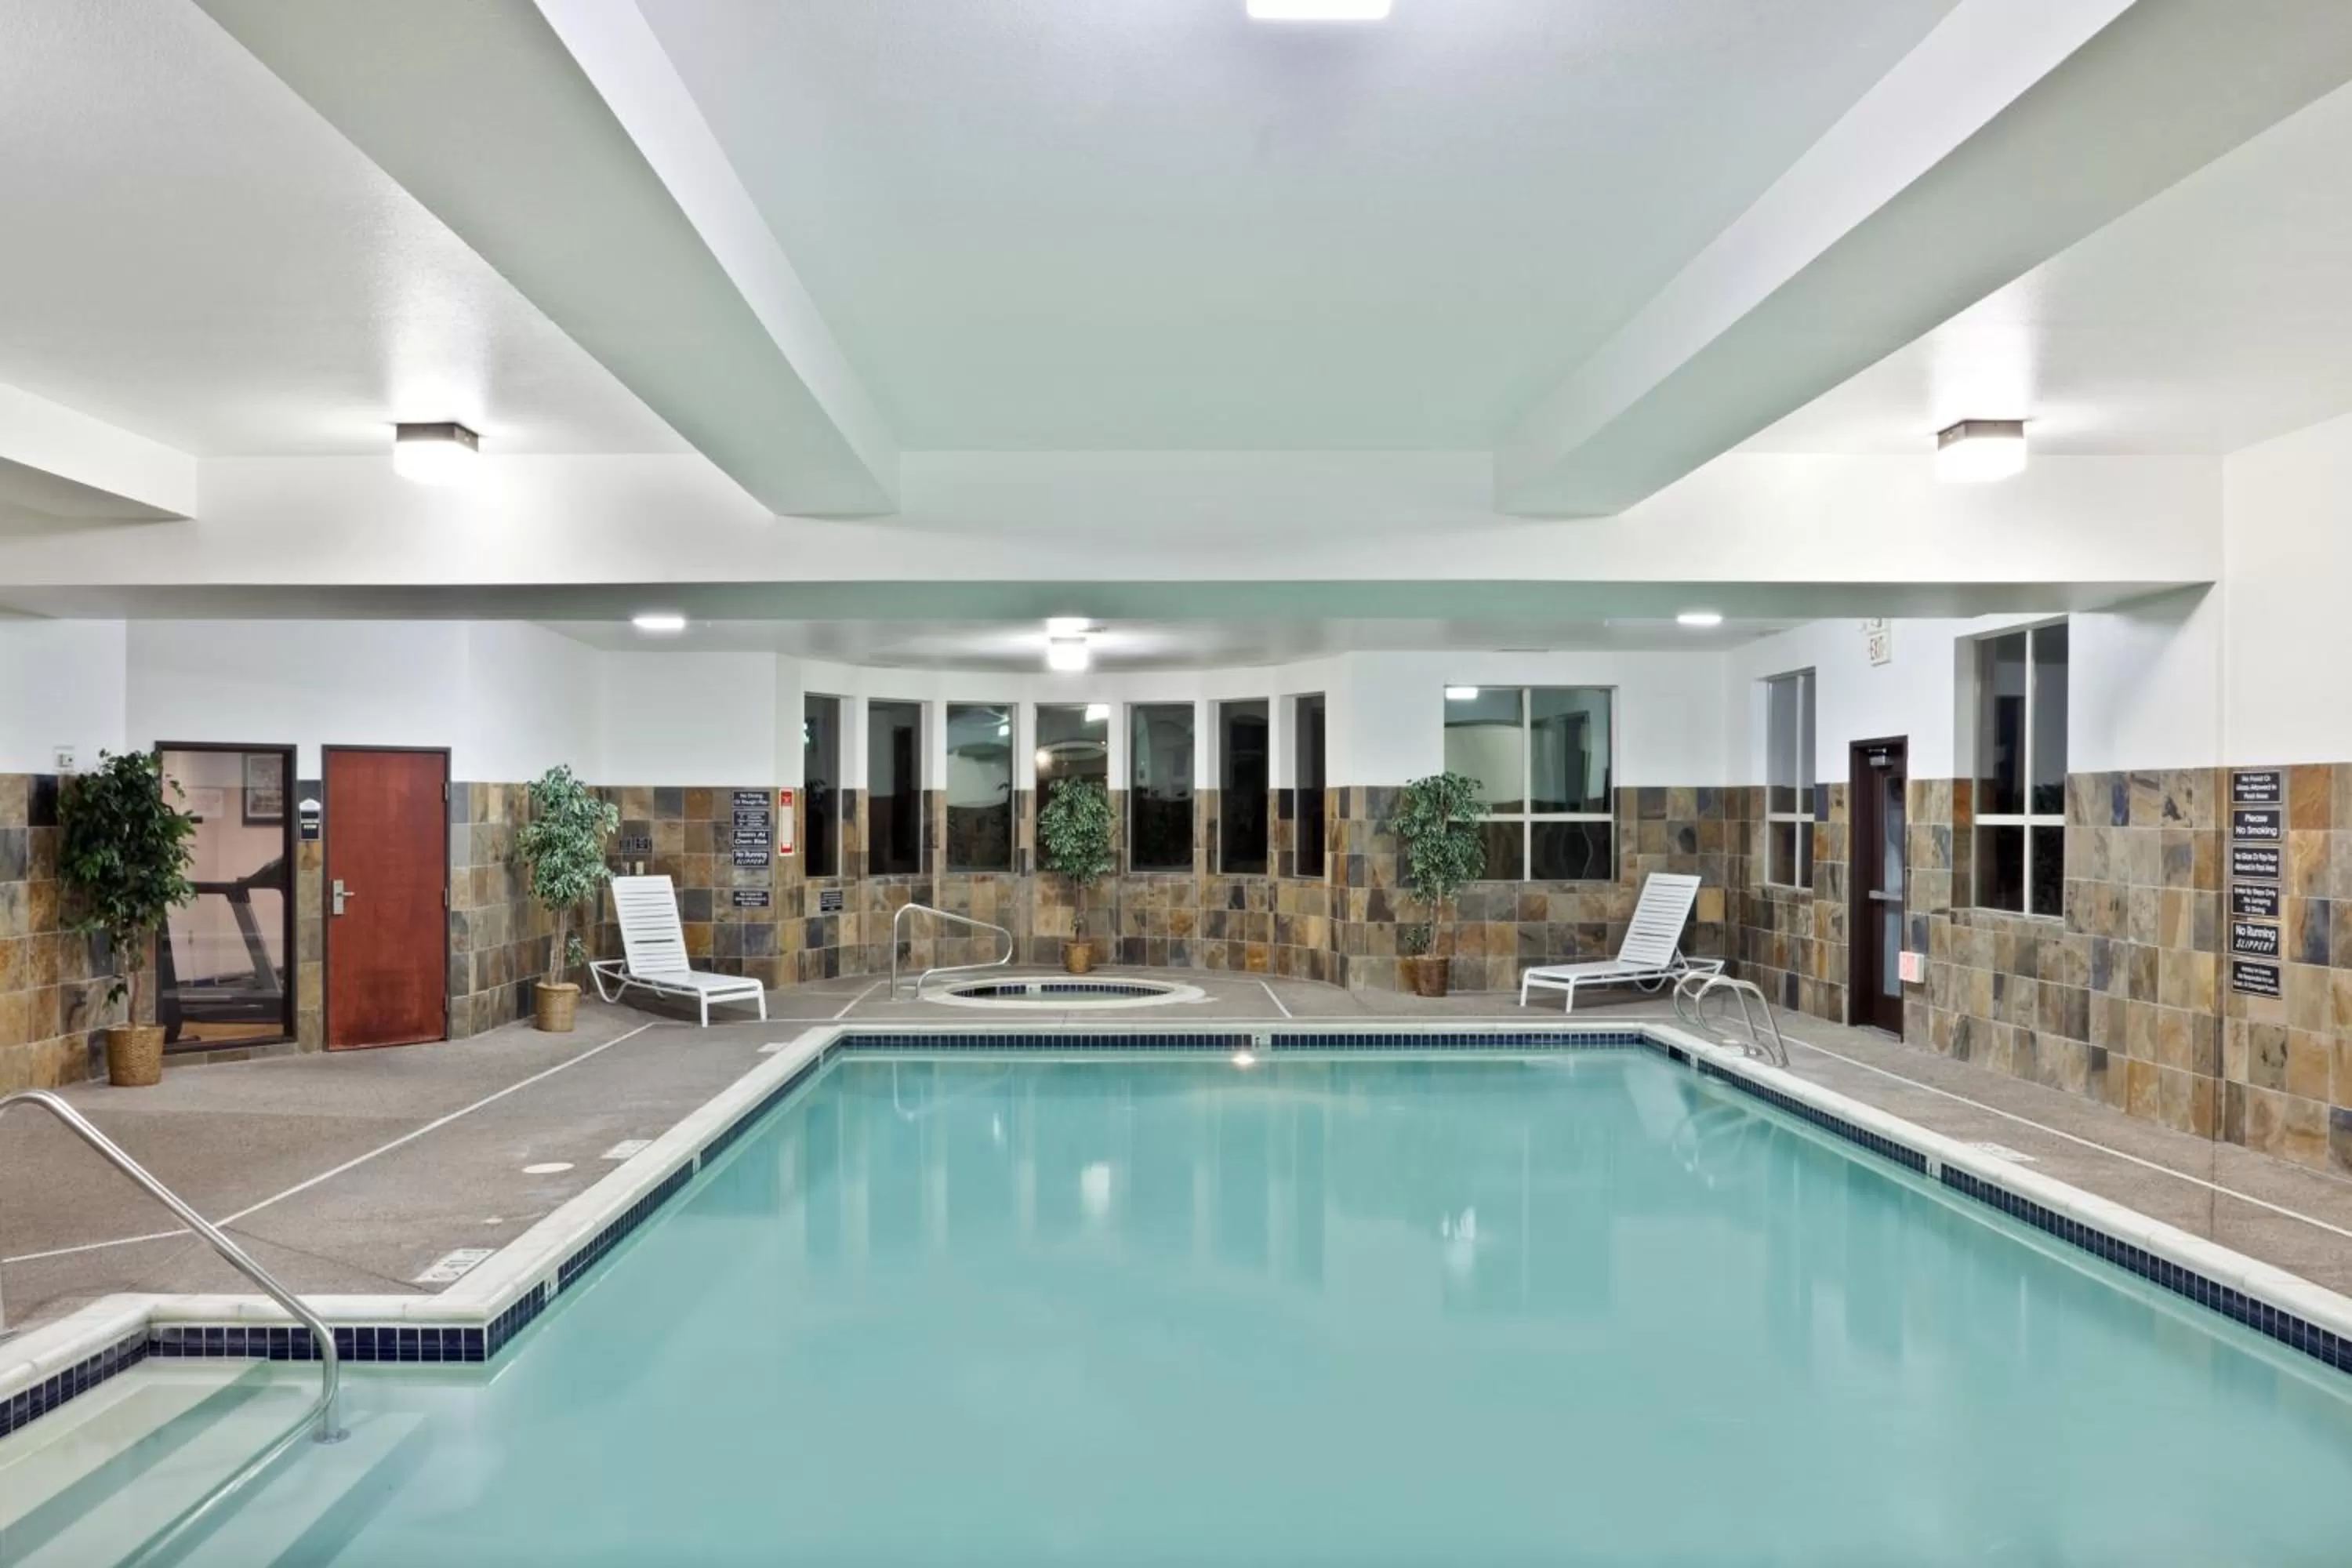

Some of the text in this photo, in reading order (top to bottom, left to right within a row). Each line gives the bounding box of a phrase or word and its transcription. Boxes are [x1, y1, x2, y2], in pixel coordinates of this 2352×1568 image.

[2235, 826, 2278, 837] No Smoking
[2236, 925, 2276, 942] No Running
[2235, 938, 2274, 951] SLIPPERY
